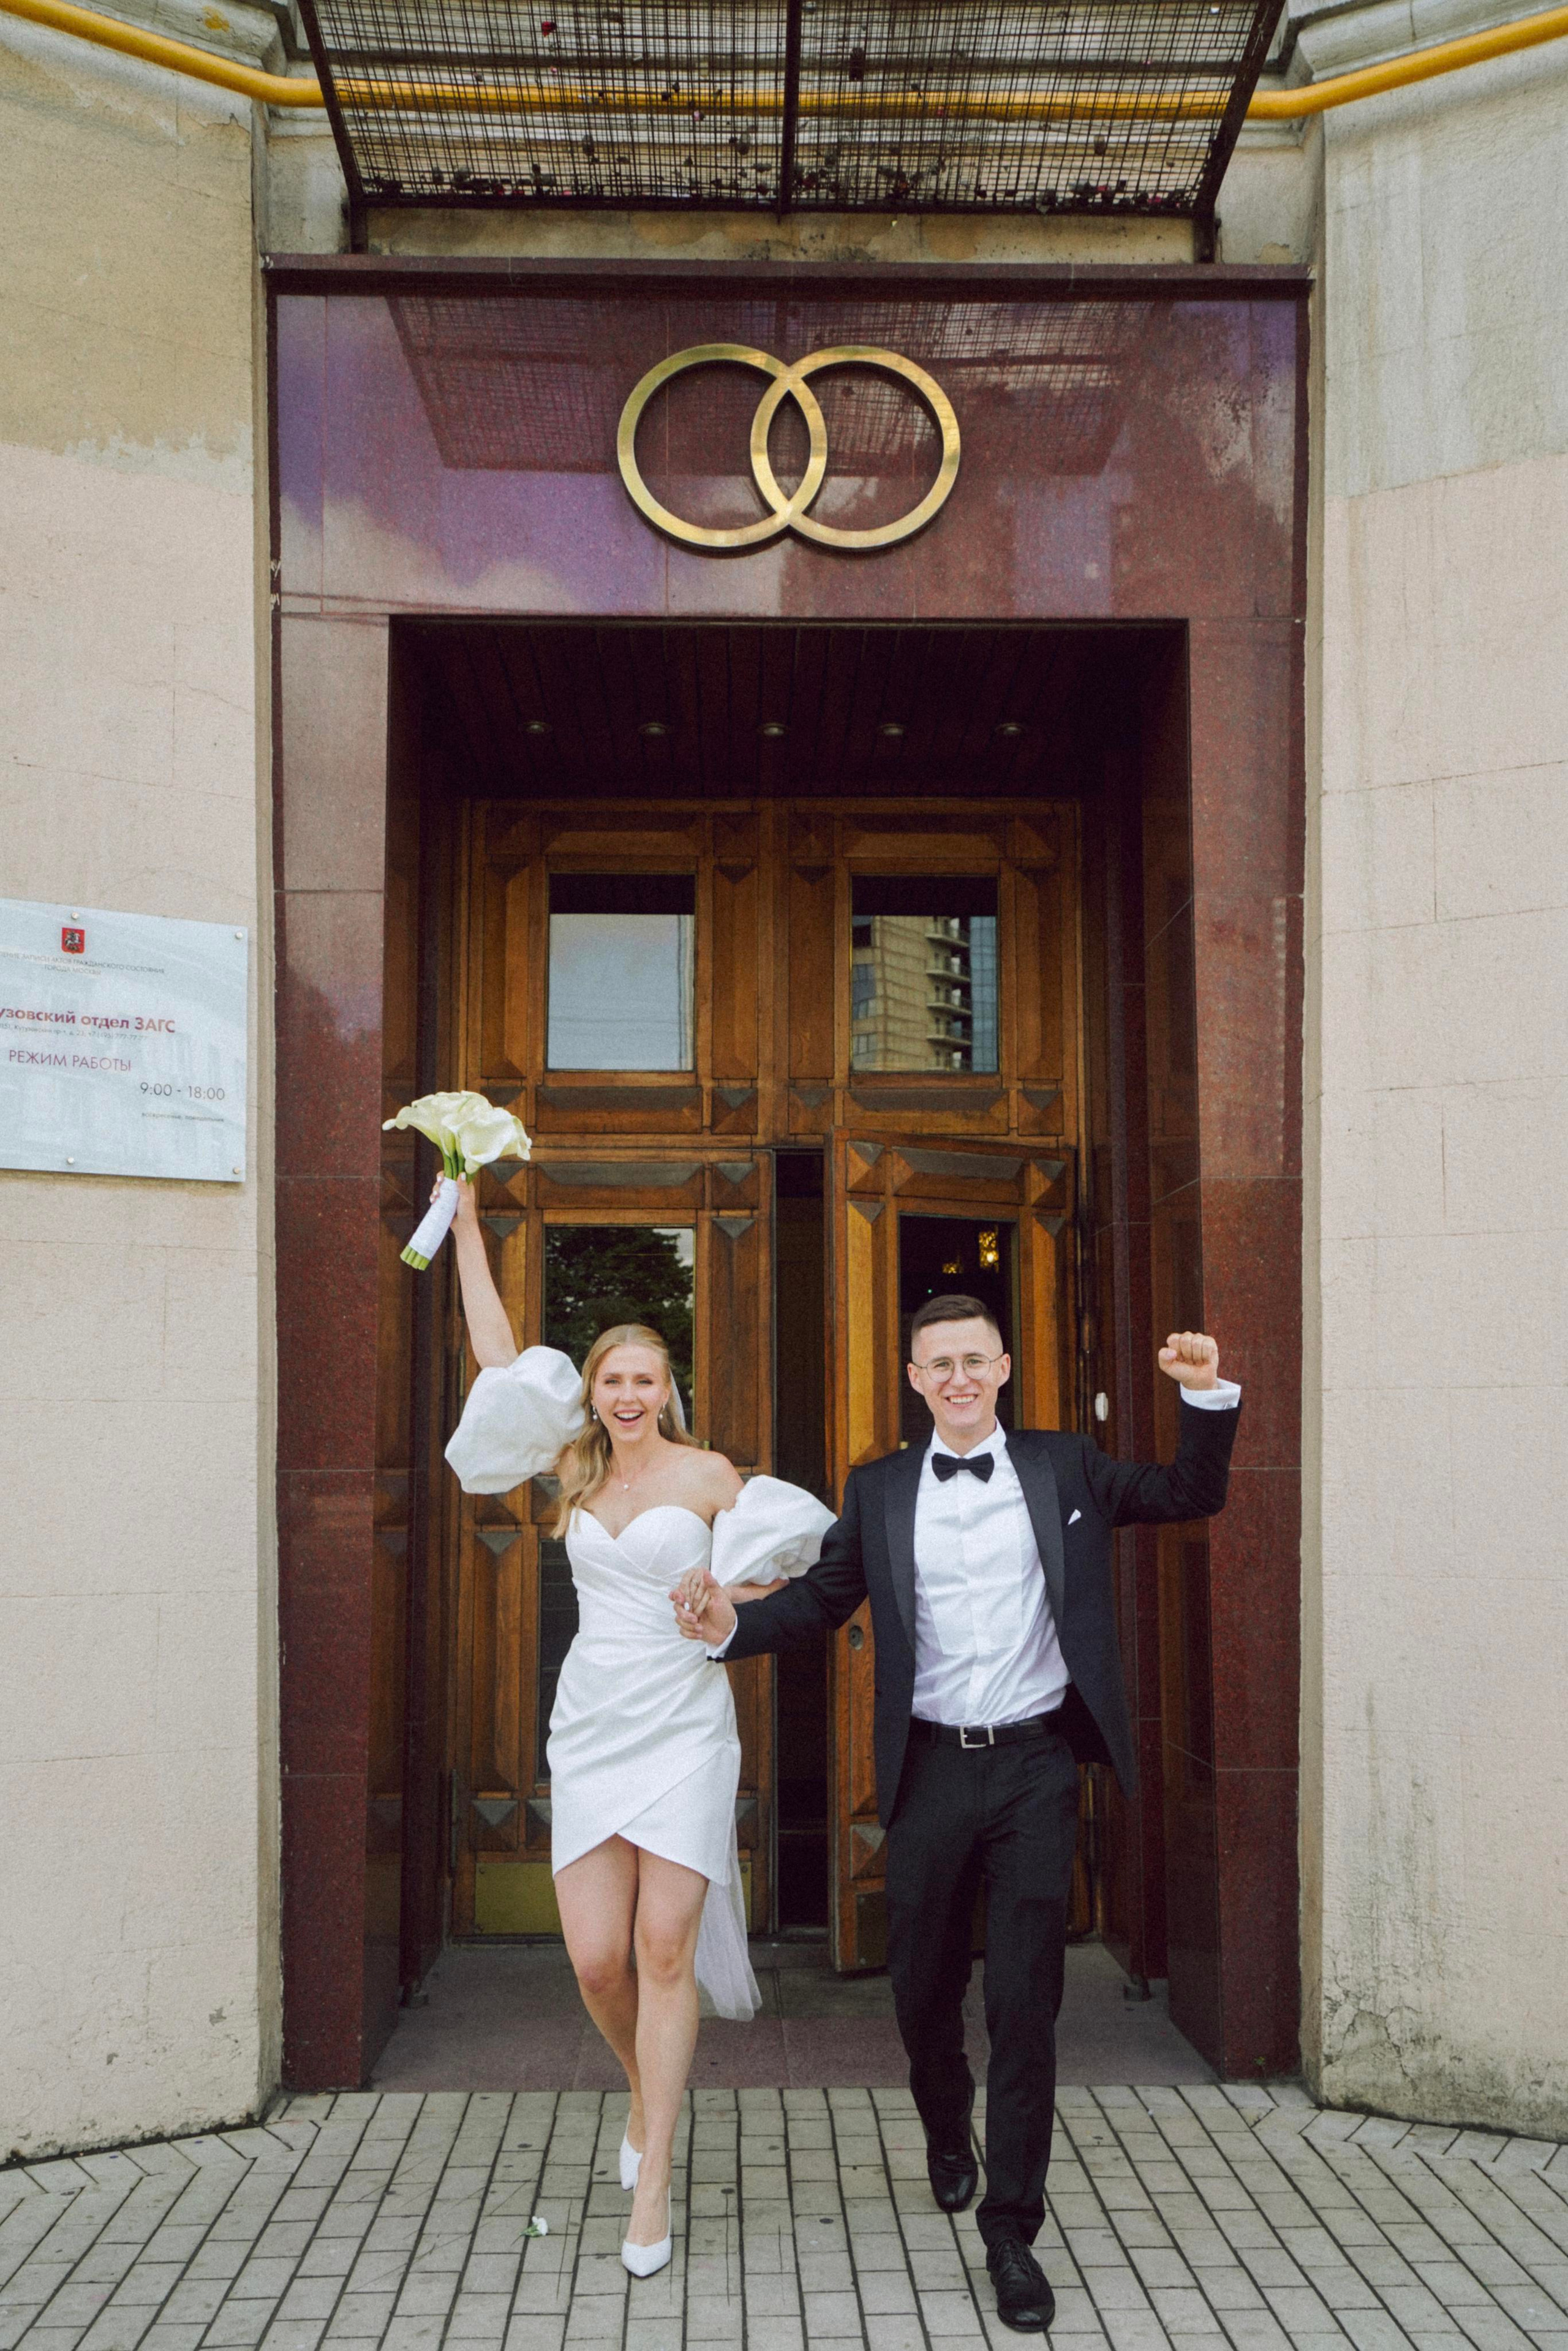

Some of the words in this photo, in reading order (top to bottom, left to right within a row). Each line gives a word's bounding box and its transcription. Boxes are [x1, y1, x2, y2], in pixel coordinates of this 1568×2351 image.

[81, 1016, 129, 1030] отдел
[135, 1017, 176, 1033] ЗАГС
[9, 1049, 67, 1067] РЕЖИМ
[72, 1055, 131, 1071] РАБОТЫ
[140, 1082, 172, 1096] 9:00
[188, 1085, 225, 1100] 18:00
